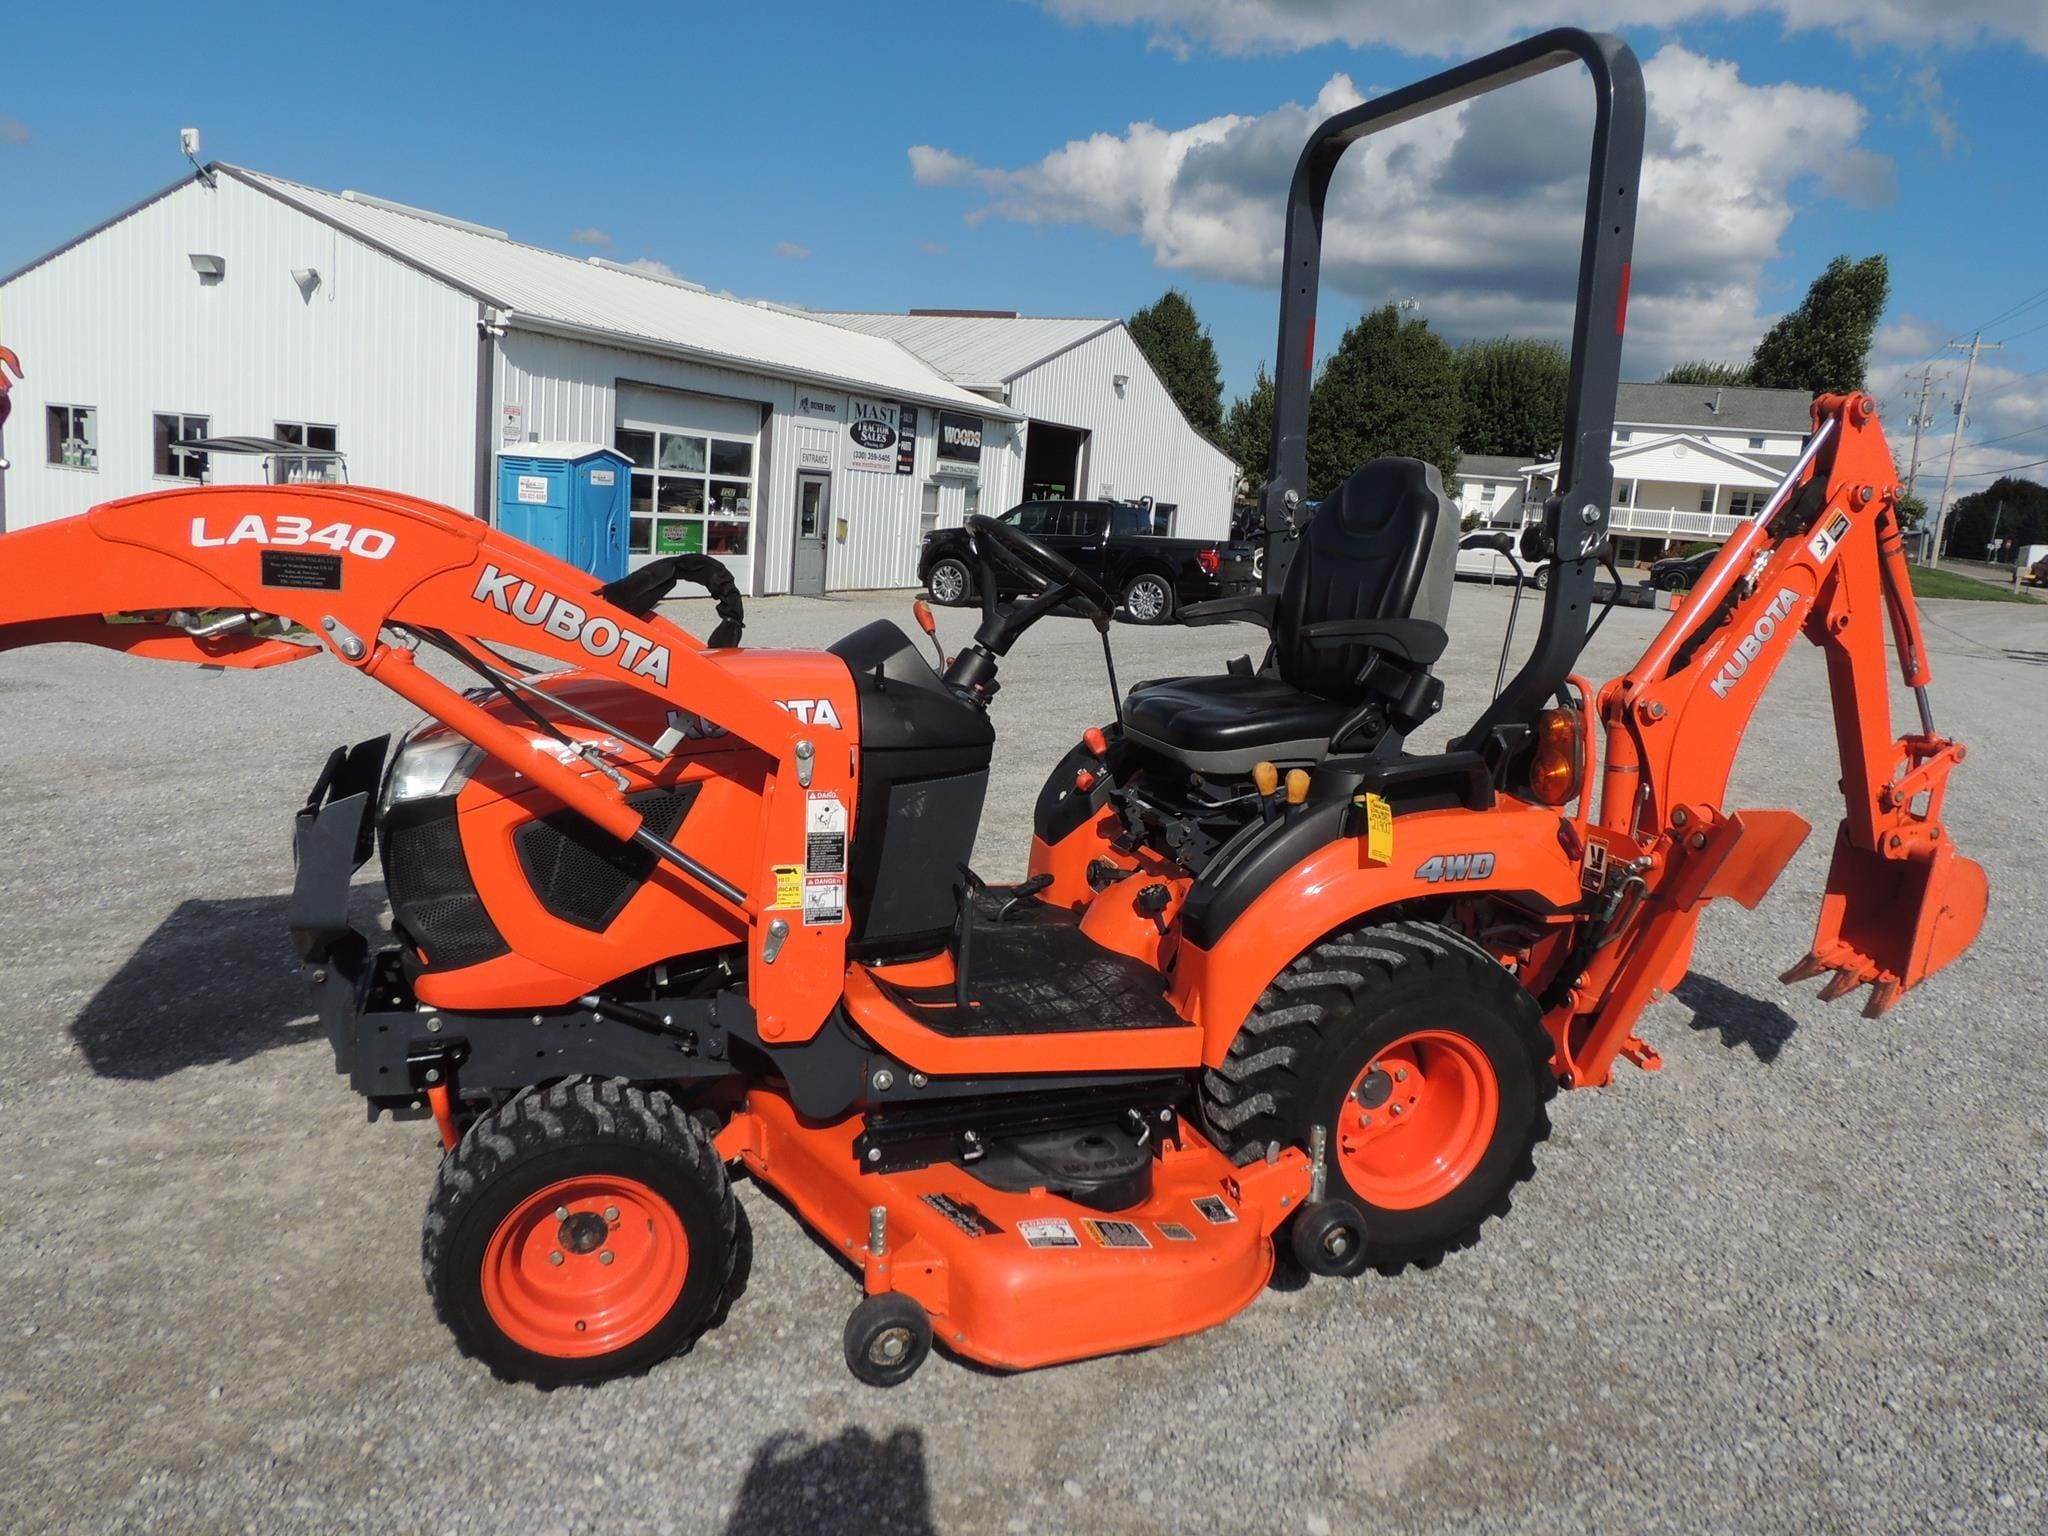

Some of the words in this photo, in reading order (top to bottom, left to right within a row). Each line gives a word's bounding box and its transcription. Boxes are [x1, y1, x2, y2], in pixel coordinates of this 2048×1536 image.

[854, 403, 896, 424] MAST
[858, 419, 890, 435] TRACTOR
[861, 431, 887, 443] SALES
[944, 426, 981, 448] WOODS
[802, 453, 828, 464] ENTRANCE
[191, 514, 396, 560] LA340
[472, 563, 671, 687] KUBOTA
[1709, 587, 1800, 699] KUBOTA
[1414, 852, 1496, 883] 4WD
